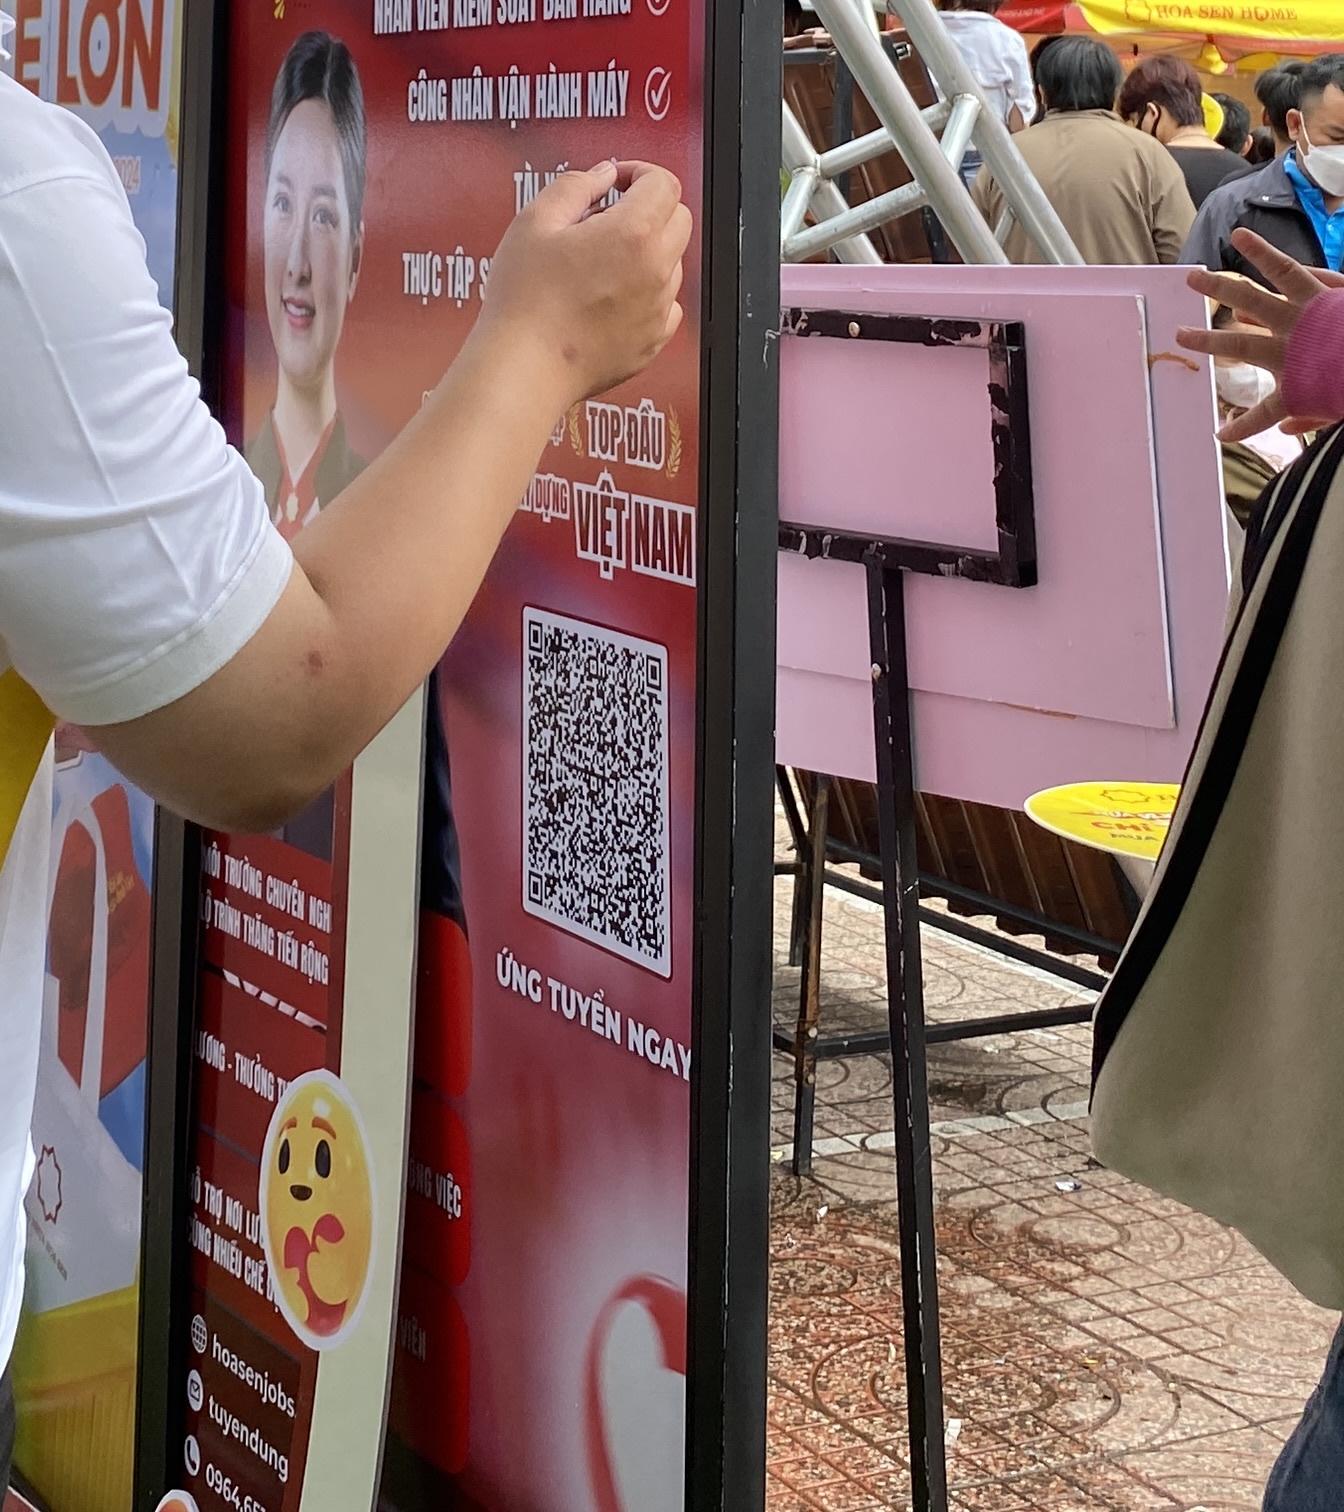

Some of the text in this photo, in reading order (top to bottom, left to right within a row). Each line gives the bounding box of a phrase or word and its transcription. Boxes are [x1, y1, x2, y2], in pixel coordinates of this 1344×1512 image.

[1154, 4, 1193, 19] HOA
[1198, 5, 1234, 20] SEN
[1241, 6, 1298, 21] HOME
[408, 58, 629, 129] CÔNG NHÂN VẬN HÀNH MÁY
[402, 251, 442, 305] THỰC
[446, 245, 475, 307] TẬP
[586, 401, 623, 462] TOP
[624, 399, 665, 469] ĐẦU
[573, 472, 628, 578] VIỆT
[631, 495, 696, 586] NAM
[224, 855, 263, 899] TRƯỜNG
[266, 879, 305, 920] CHUYÊN
[214, 898, 241, 939] TRÌNH
[243, 913, 274, 956] THĂNG
[277, 930, 298, 969] TIẾN
[301, 940, 329, 985] RỘNG
[496, 946, 691, 1082] ỨNG TUYỂN NGAY
[235, 1053, 275, 1101] THƯỞNG
[204, 1180, 223, 1225] TRỢ
[225, 1195, 243, 1234] NƠI
[435, 1172, 462, 1220] VIỆC
[213, 1233, 242, 1279] NHIỀU
[244, 1256, 267, 1295] CHẾ
[209, 1395, 289, 1483] tuyendung
